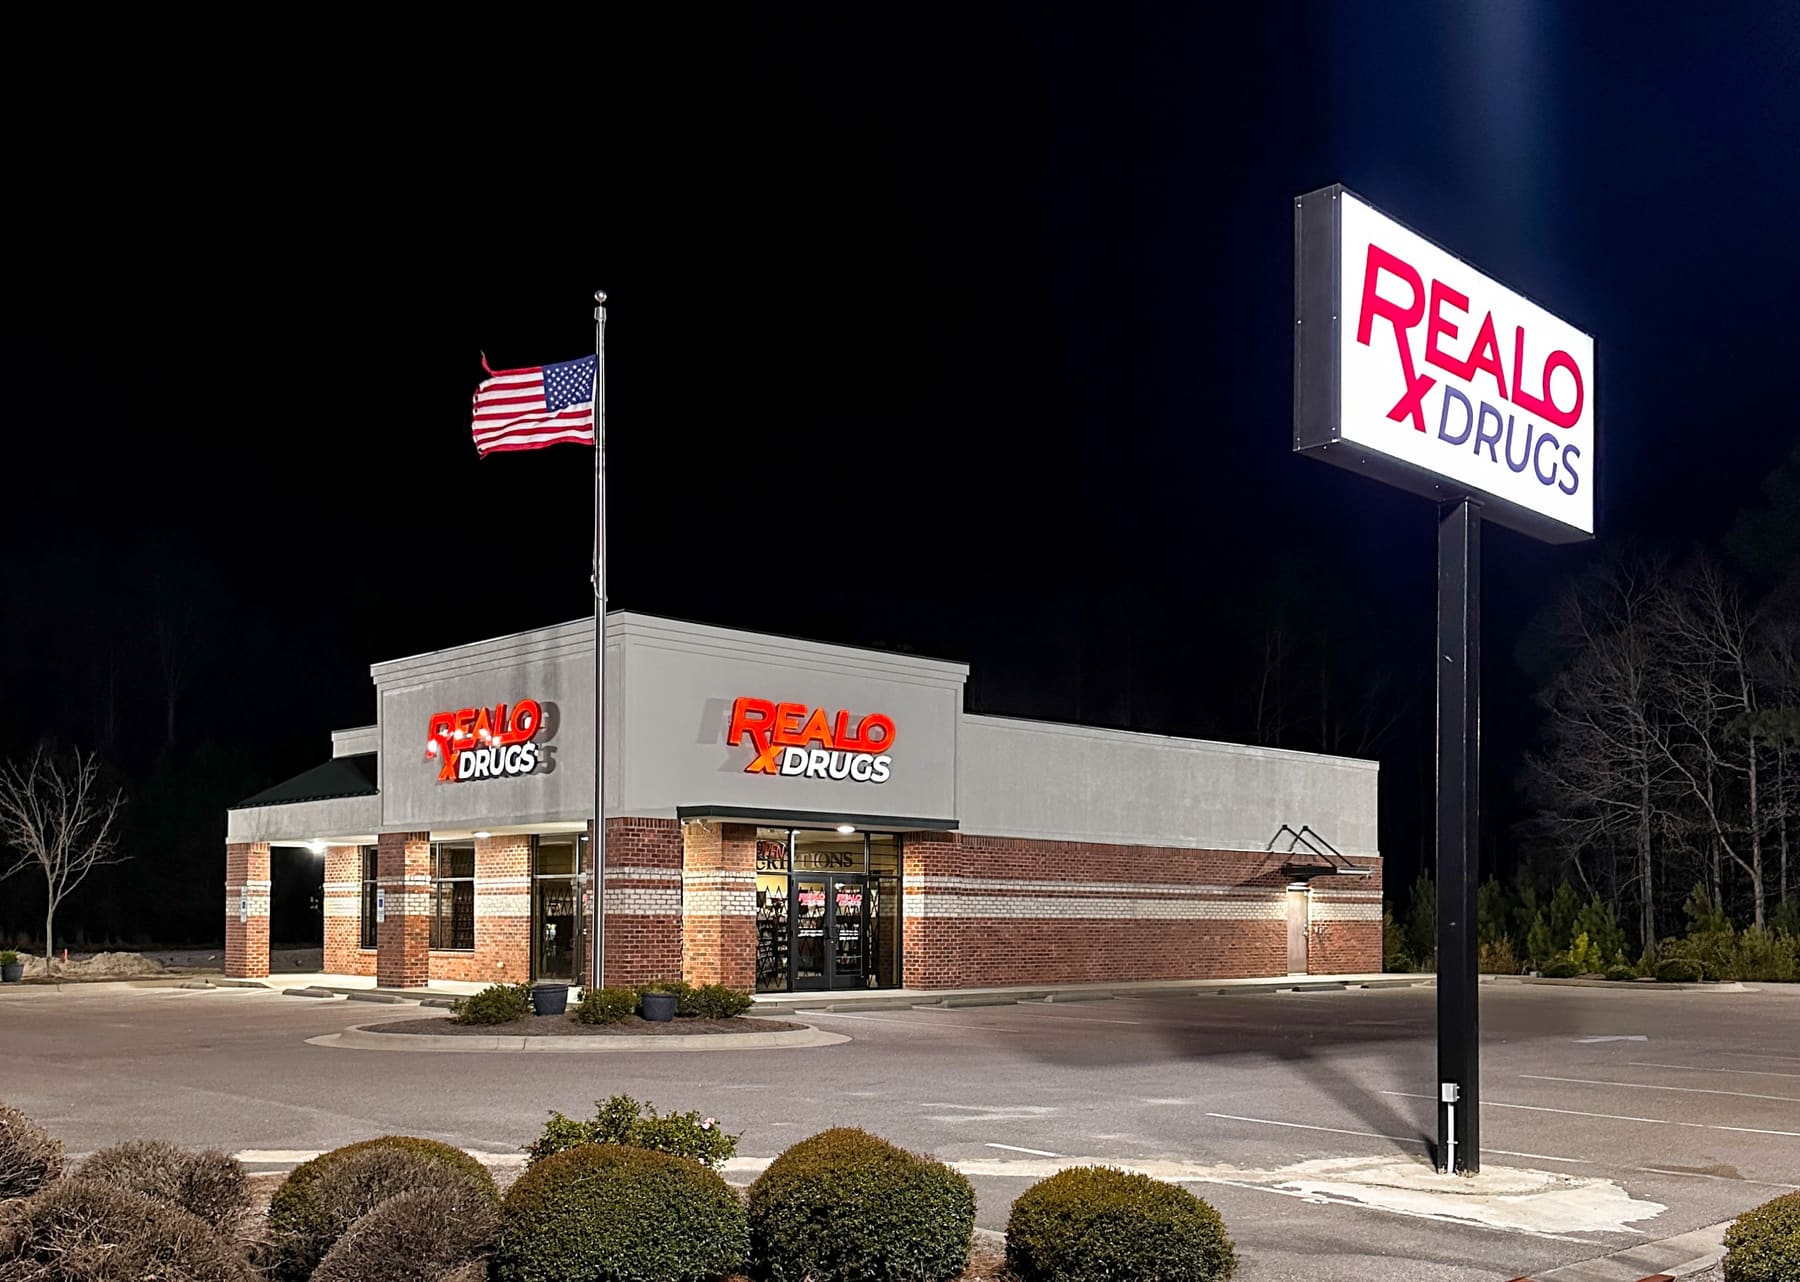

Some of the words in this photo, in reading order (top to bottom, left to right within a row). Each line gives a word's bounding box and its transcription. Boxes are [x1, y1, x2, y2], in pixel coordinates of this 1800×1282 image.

[1357, 243, 1584, 429] REALO
[1438, 385, 1581, 495] DRUGS
[426, 698, 542, 759] REALO
[727, 696, 896, 755] REALO
[458, 741, 538, 780] DRUGS
[781, 747, 892, 783] DRUGS
